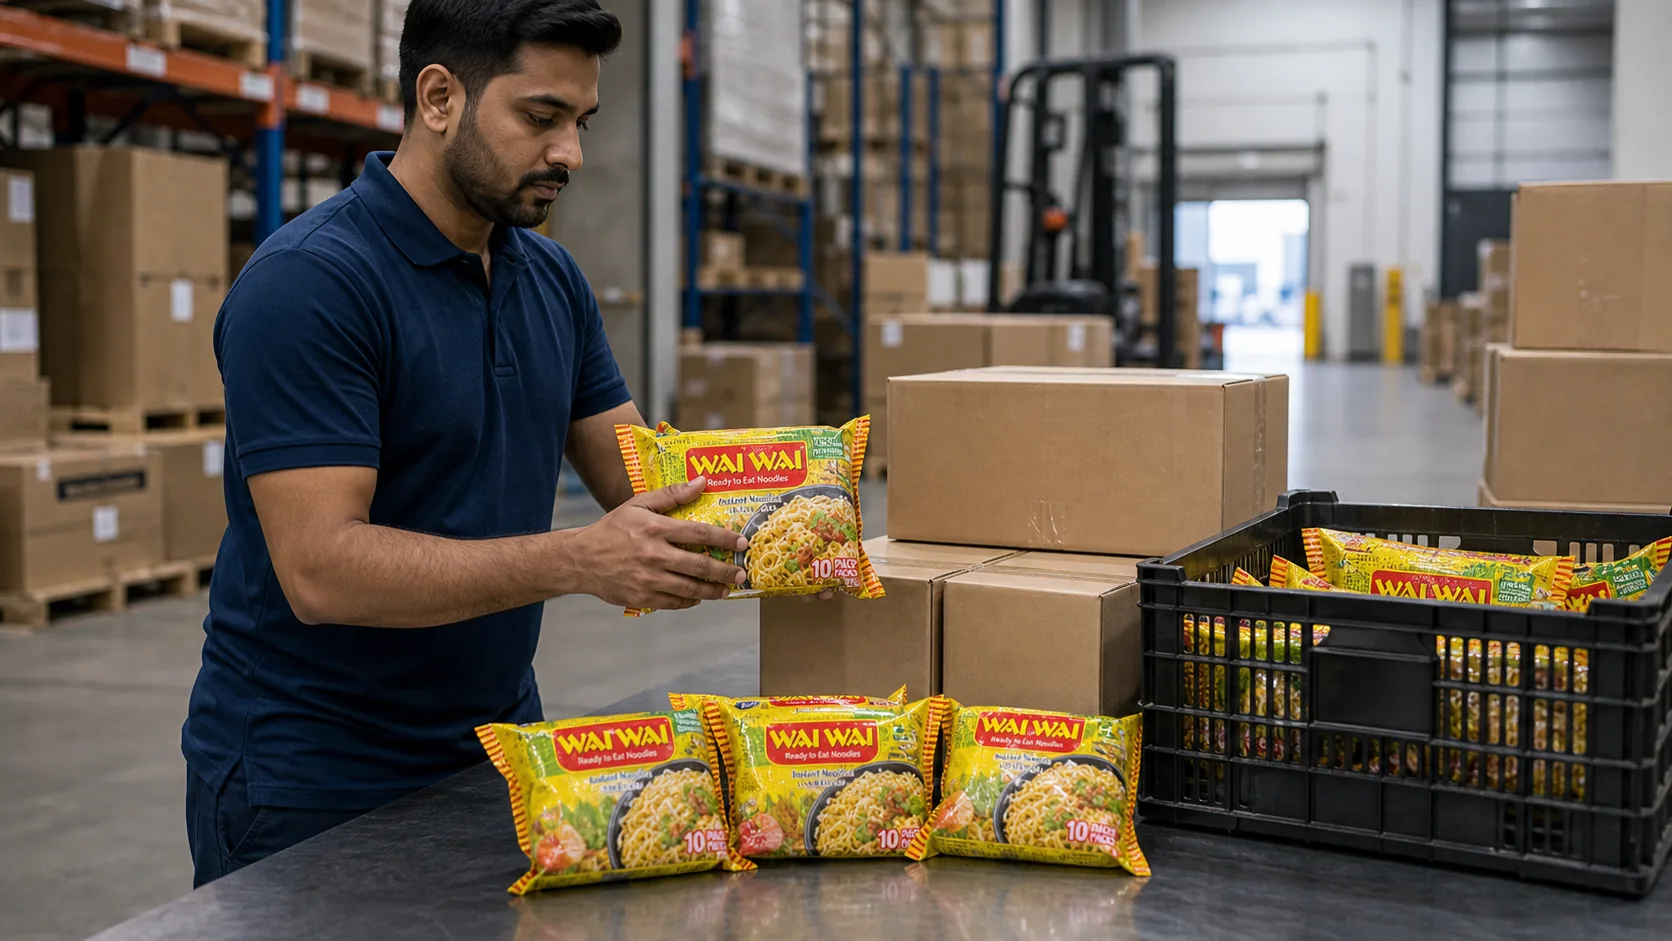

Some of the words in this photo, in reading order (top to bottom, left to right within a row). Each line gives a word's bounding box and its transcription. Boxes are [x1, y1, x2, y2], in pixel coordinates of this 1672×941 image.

[689, 453, 744, 475] WAI
[748, 449, 803, 472] WAI
[707, 478, 731, 488] Ready
[743, 476, 755, 485] Eat
[757, 474, 789, 483] Noodles
[811, 558, 832, 579] 10
[769, 728, 819, 750] WAI
[823, 727, 873, 749] WAI
[981, 716, 1029, 736] WAI
[1032, 719, 1080, 740] WAI
[557, 730, 613, 755] WAI
[614, 724, 669, 748] WAI
[578, 756, 602, 766] Ready
[603, 754, 612, 762] to
[613, 752, 625, 761] Eat
[626, 749, 657, 760] Noodles
[785, 752, 807, 761] Ready
[818, 751, 830, 759] Eat
[831, 749, 861, 759] Noodles
[684, 831, 705, 853] 10
[878, 829, 899, 849] 10
[1066, 820, 1089, 842] 10
